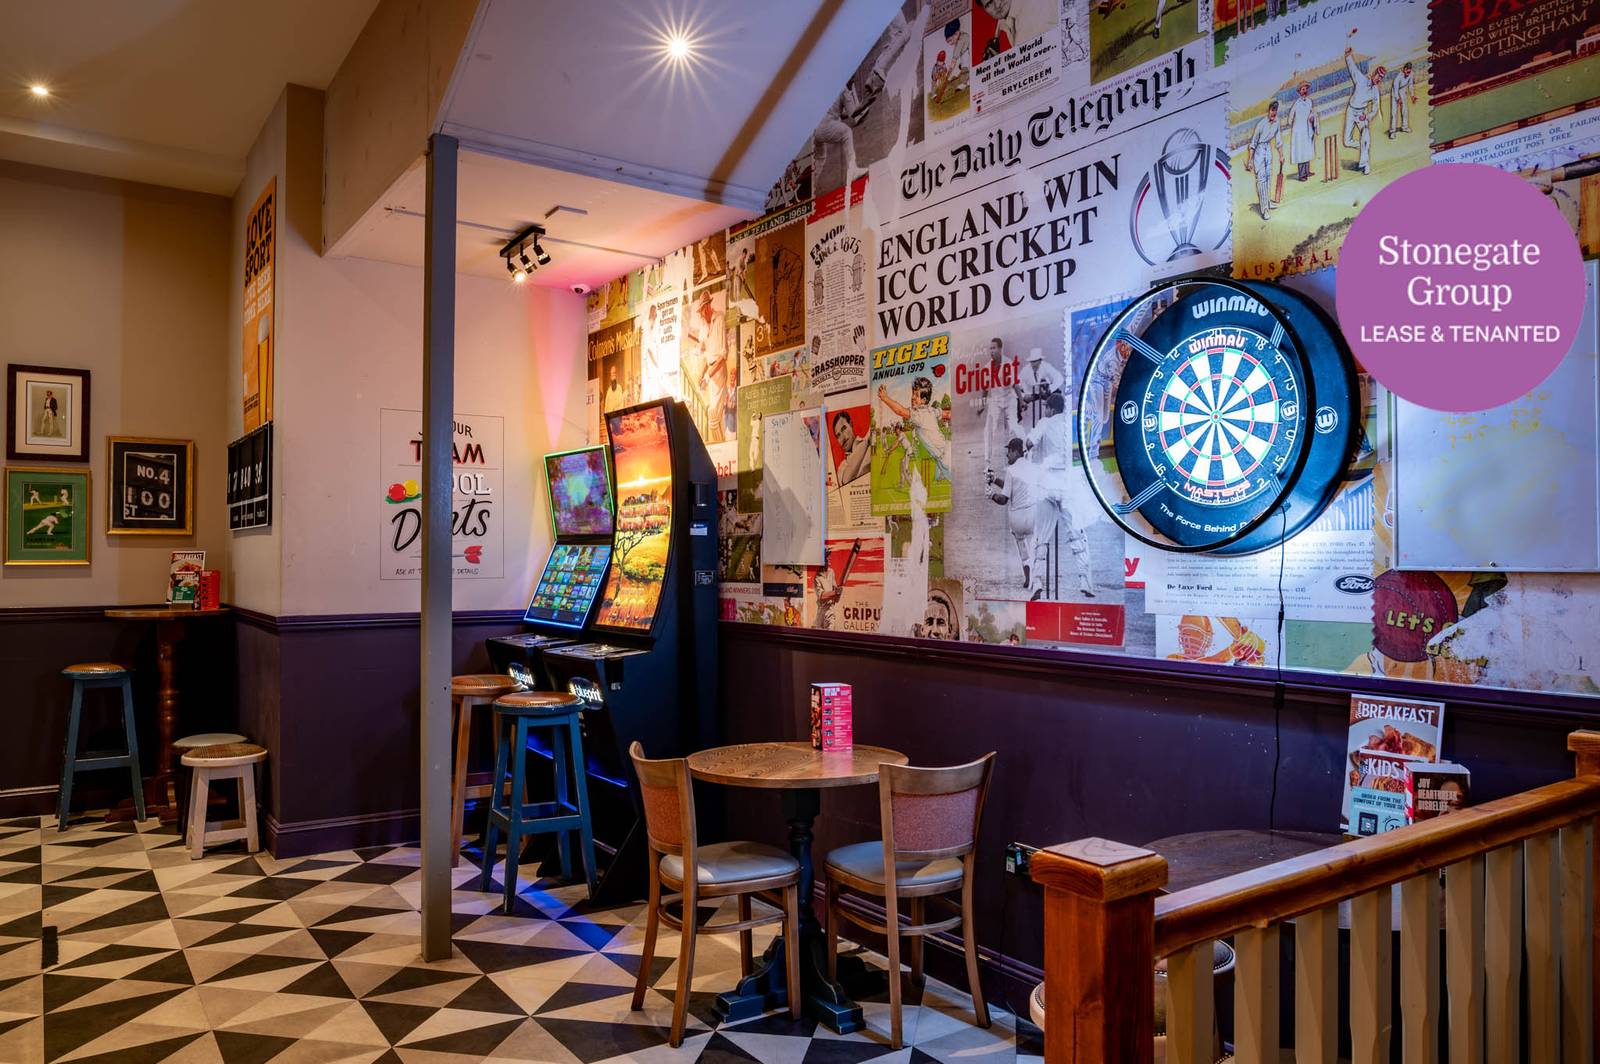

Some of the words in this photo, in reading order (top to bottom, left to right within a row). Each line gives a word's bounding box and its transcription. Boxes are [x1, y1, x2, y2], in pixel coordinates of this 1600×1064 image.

[1285, 14, 1318, 38] Shield
[1459, 27, 1484, 41] AND
[1489, 13, 1526, 29] EVERY
[1530, 0, 1578, 15] ARTIC
[1488, 23, 1519, 40] WITH
[1526, 3, 1575, 27] BRITISH
[1457, 9, 1588, 64] NOTTINGHAM
[1498, 39, 1540, 56] ENGLAND
[976, 64, 991, 76] Men
[994, 57, 1001, 67] of
[1004, 52, 1016, 62] the
[1019, 37, 1043, 54] World
[981, 73, 991, 83] all
[994, 67, 1005, 77] the
[1008, 54, 1031, 70] World
[1135, 64, 1157, 78] QUALITY
[1158, 58, 1173, 68] DAILY
[1001, 66, 1052, 96] BRYLCREEM
[900, 160, 946, 201] The
[950, 129, 1023, 184] Daily
[1028, 48, 1196, 148] Telegraph
[1461, 147, 1488, 160] SPORTS
[1494, 132, 1542, 149] OUTFITTERS
[1473, 146, 1520, 164] CATALOGUE
[1526, 138, 1545, 149] POST
[1551, 131, 1572, 143] FREE
[877, 190, 1029, 270] ENGLAND
[1043, 153, 1121, 213] WIN
[246, 194, 272, 257] LOVE
[840, 236, 861, 254] 1875
[877, 261, 927, 305] ICC
[936, 206, 1099, 283] CRICKET
[244, 232, 272, 288] SPORT
[878, 283, 991, 340] WORLD
[1002, 258, 1077, 307] CUP
[1192, 295, 1269, 319] WINMAU
[588, 336, 615, 361] Colman's
[872, 335, 949, 369] TIGER
[1188, 334, 1246, 353] WINMAU
[872, 366, 905, 380] ANNUAL
[907, 361, 925, 374] 1979
[955, 355, 1021, 395] Cricket
[410, 440, 485, 464] TAM
[137, 464, 170, 485] NO.4
[453, 472, 492, 495] OL
[1184, 480, 1251, 497] MASTERS
[1160, 502, 1174, 518] The
[1175, 515, 1201, 530] Force
[1204, 524, 1237, 533] Behind
[1340, 576, 1374, 590] Ford
[843, 620, 880, 632] GALLERY
[575, 683, 604, 702] blueprint
[1361, 702, 1435, 725] BREAKFAST
[1368, 757, 1400, 778] KIDS
[1418, 778, 1431, 789] JOY
[1418, 789, 1458, 801] HEARTBREAK
[1377, 795, 1392, 803] FROM
[1384, 801, 1396, 809] YOUR
